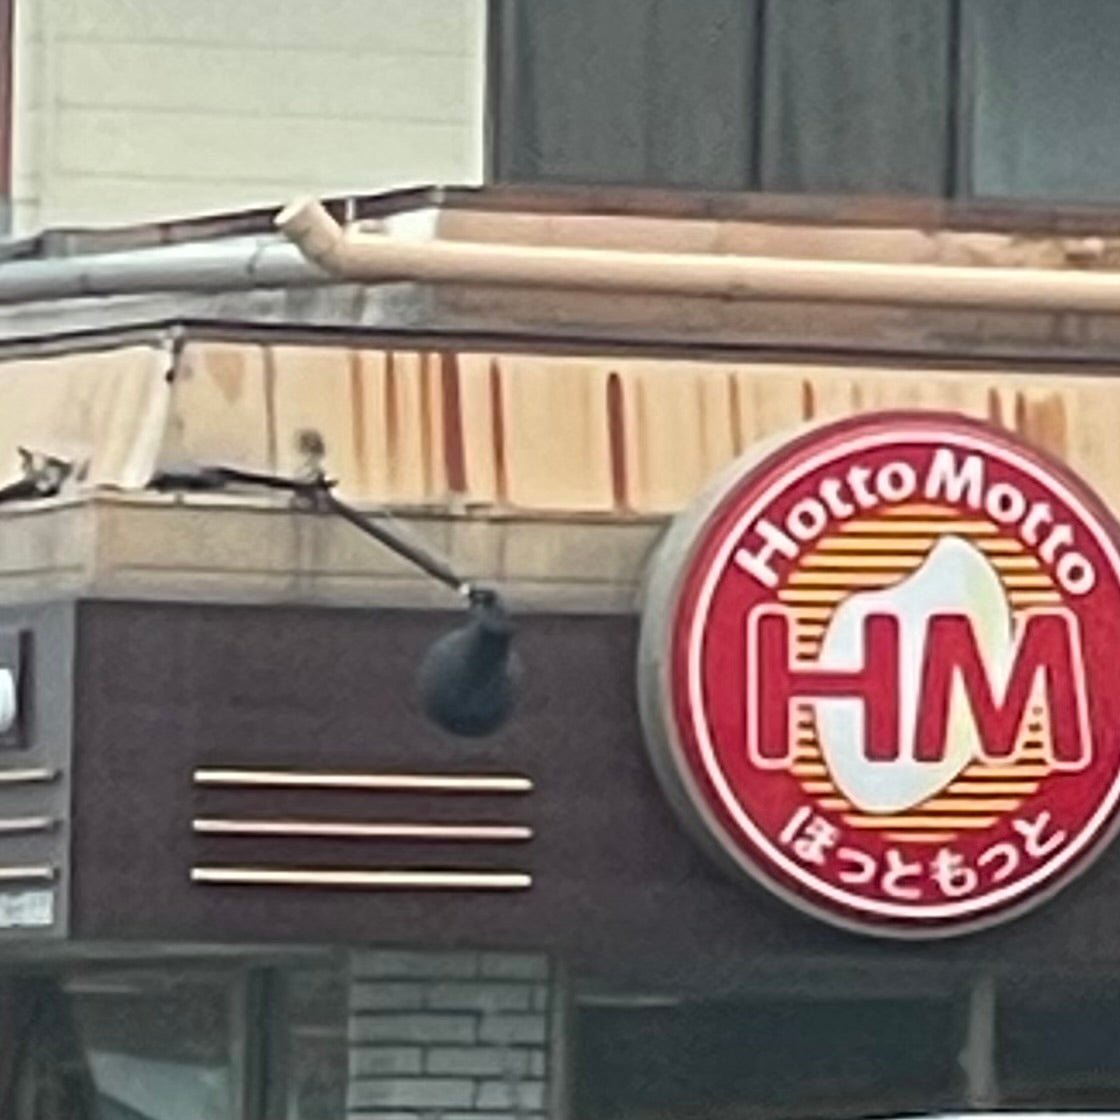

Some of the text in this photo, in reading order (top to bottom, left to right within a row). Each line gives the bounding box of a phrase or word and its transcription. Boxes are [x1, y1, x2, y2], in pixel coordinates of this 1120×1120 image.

[747, 602, 1092, 770] HM
[779, 804, 1067, 899] ほっともっと
